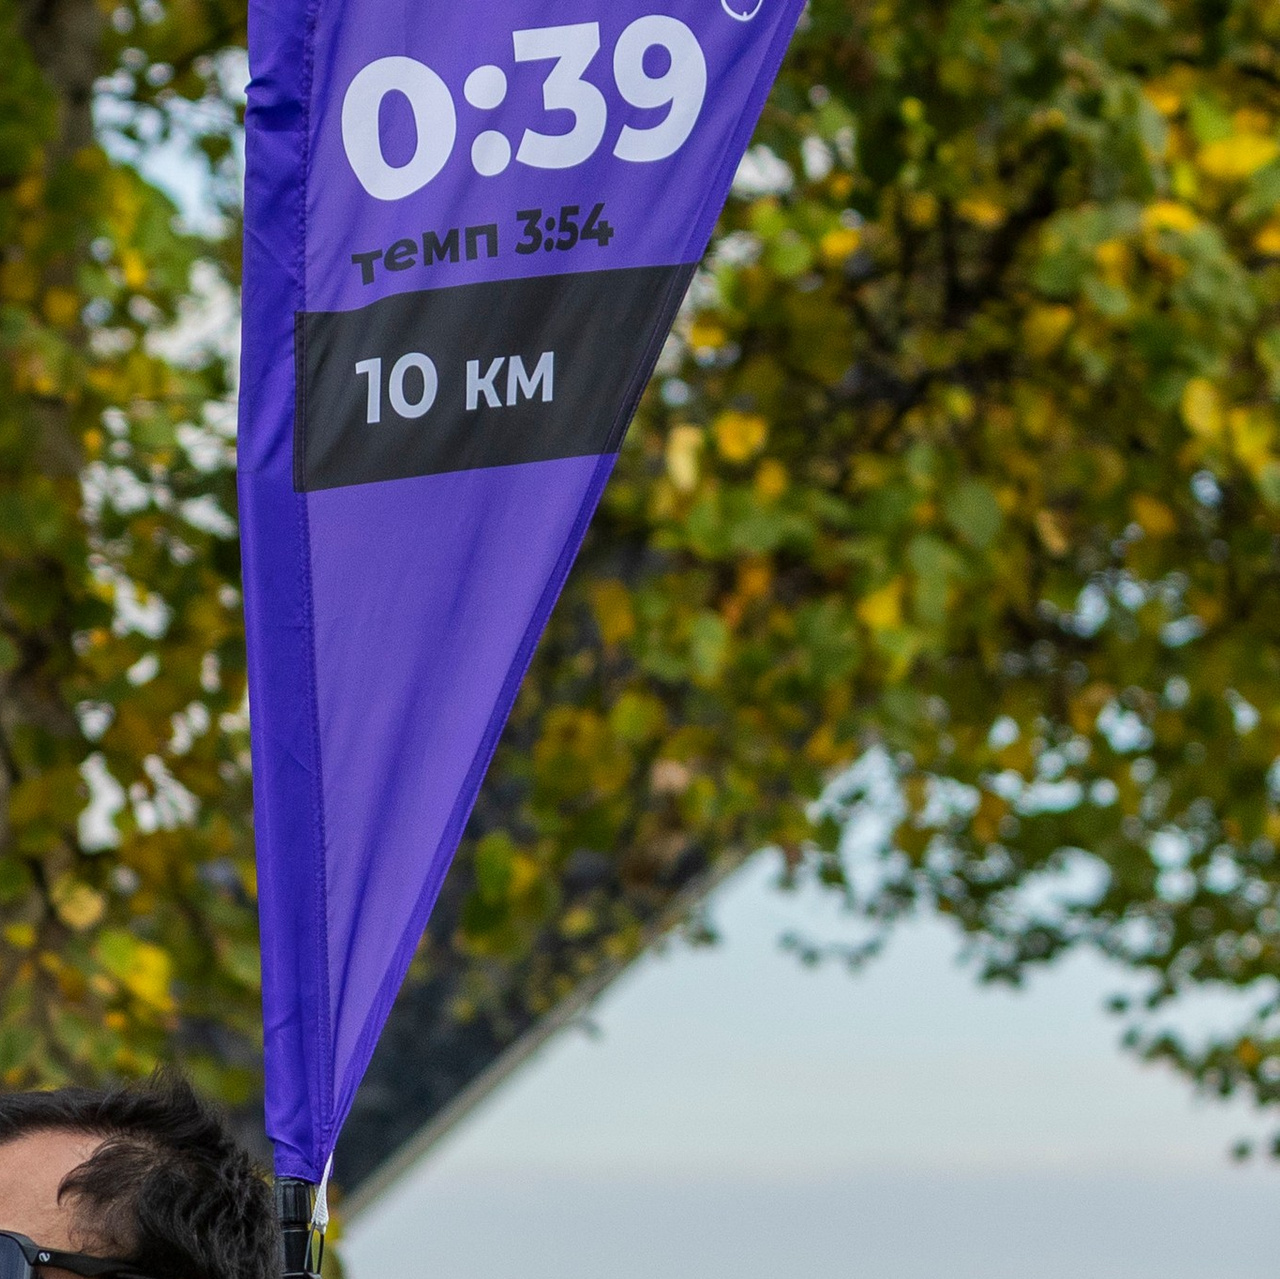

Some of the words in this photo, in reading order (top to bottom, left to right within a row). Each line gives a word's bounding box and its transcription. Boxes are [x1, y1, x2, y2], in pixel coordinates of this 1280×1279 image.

[341, 14, 707, 200] 0:39
[351, 223, 499, 285] темп
[515, 203, 614, 255] 3:54
[355, 352, 438, 424] 10
